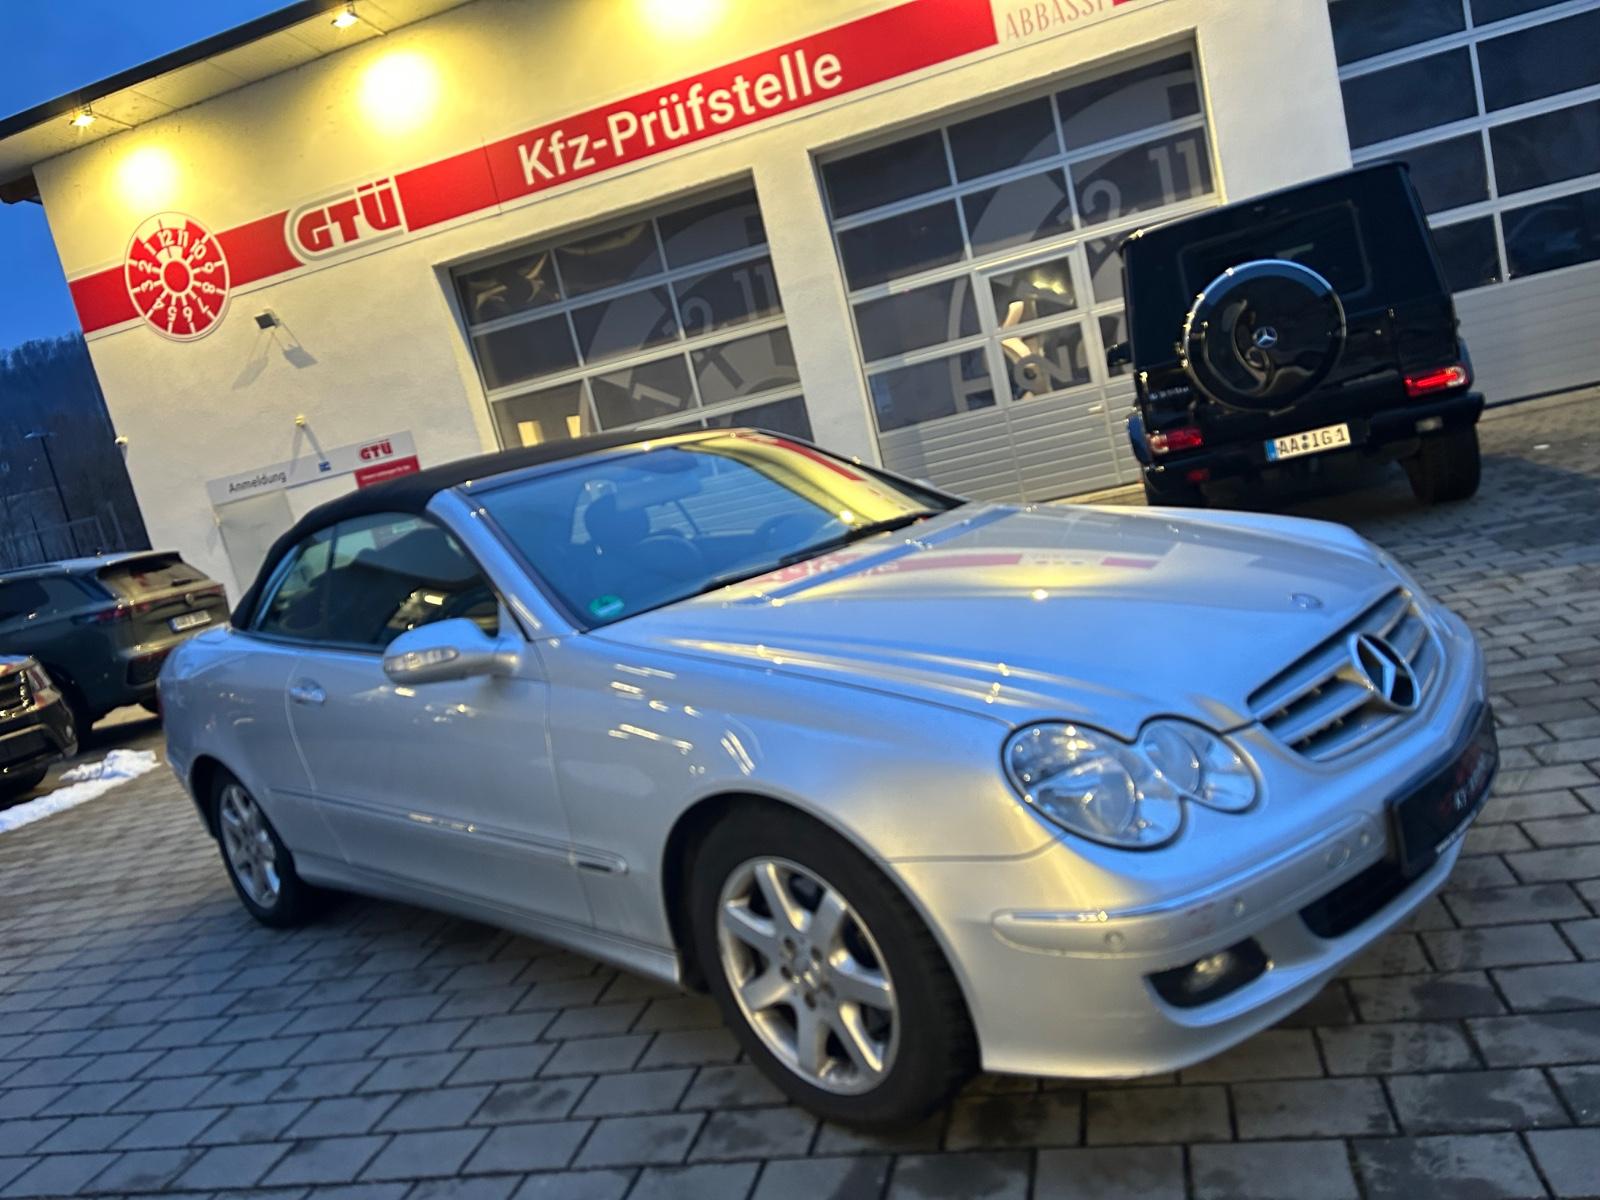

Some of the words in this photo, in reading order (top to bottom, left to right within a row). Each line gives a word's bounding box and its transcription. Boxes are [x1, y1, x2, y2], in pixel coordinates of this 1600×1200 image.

[518, 49, 842, 185] Kfz-Prüfstelle
[297, 178, 402, 252] GTÜ
[157, 229, 175, 248] 12
[177, 229, 188, 248] 11
[190, 239, 206, 259] 10
[1280, 438, 1300, 455] AA
[229, 471, 287, 493] Anmeldung
